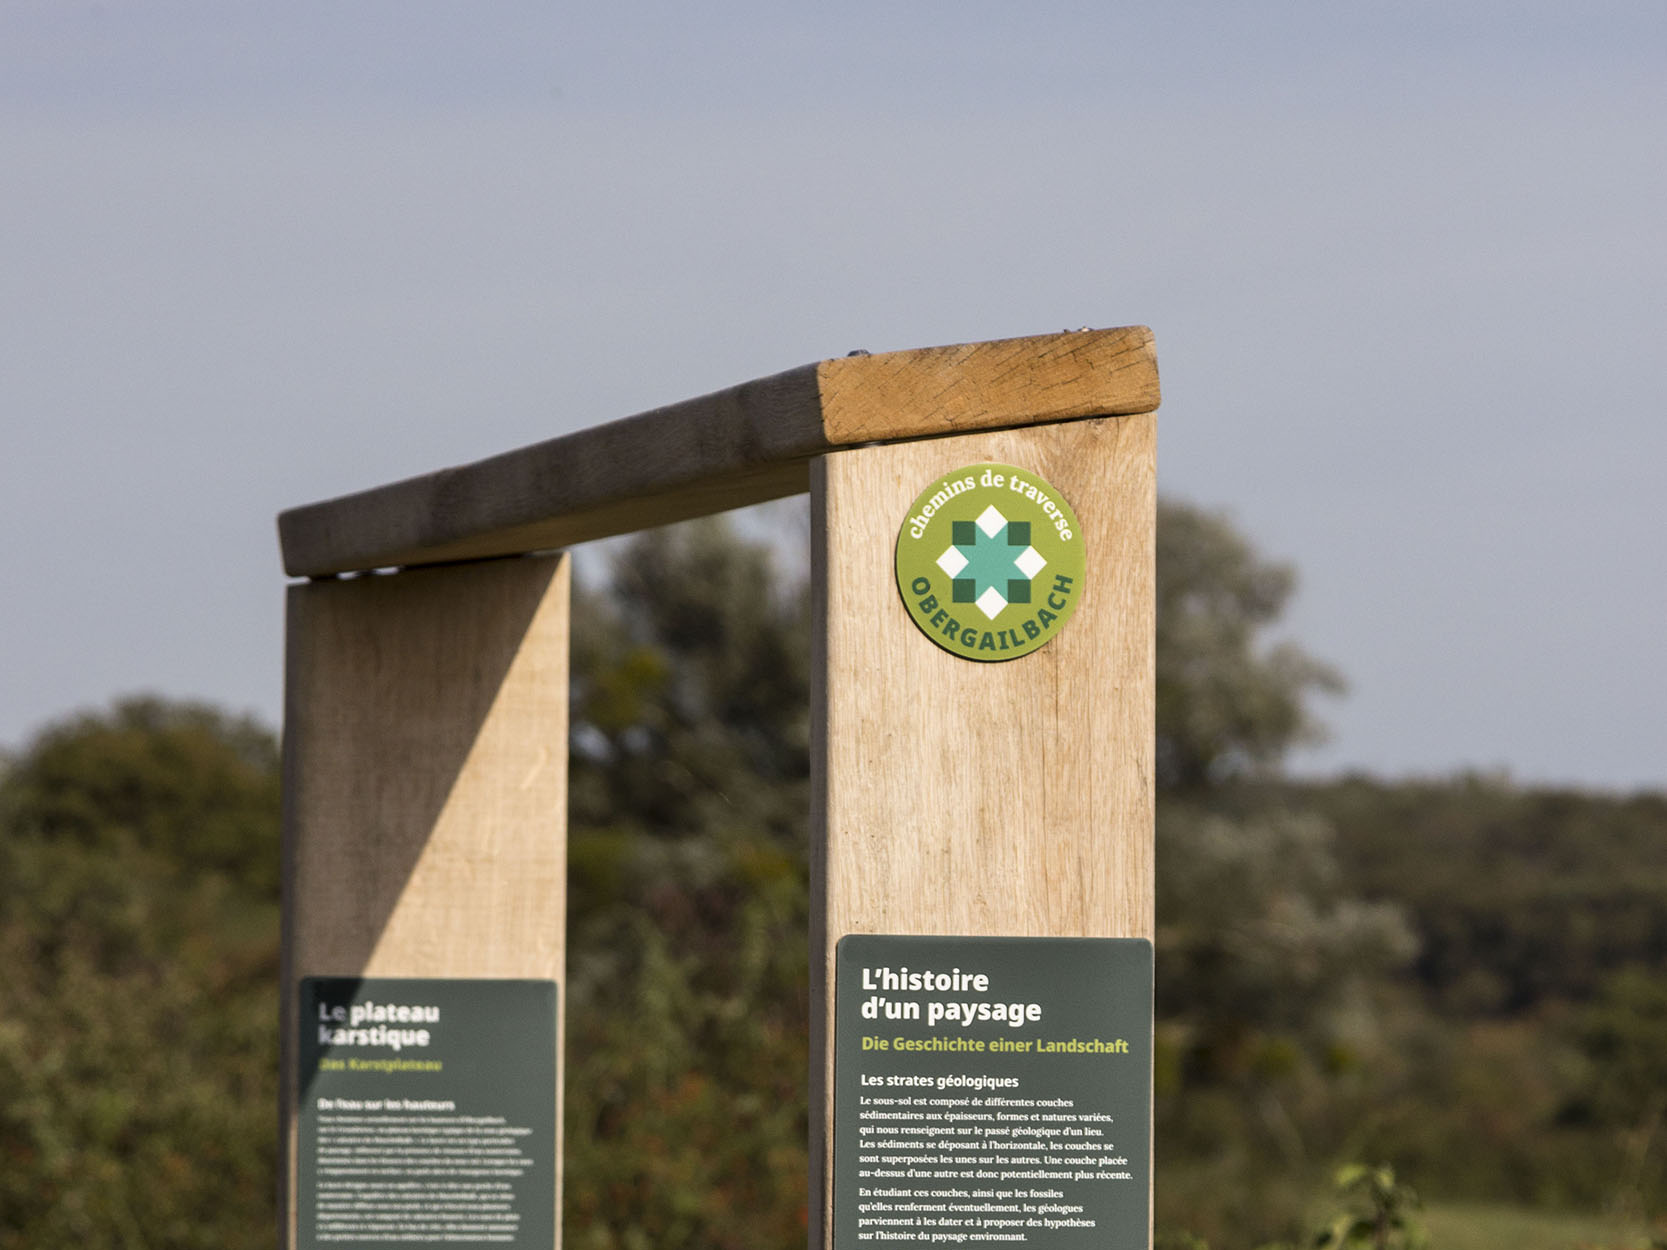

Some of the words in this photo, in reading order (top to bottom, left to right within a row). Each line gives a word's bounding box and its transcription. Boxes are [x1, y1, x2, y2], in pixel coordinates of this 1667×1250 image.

[910, 476, 976, 539] chemins
[980, 469, 1004, 487] de
[1010, 476, 1073, 541] traverse
[912, 574, 1074, 651] OBERGAILBACH
[862, 967, 989, 992] L'histoire
[319, 1002, 346, 1022] Le
[350, 1001, 440, 1026] plateau
[861, 996, 920, 1020] d'un
[928, 1003, 1042, 1027] paysage
[318, 1025, 431, 1051] karstique
[862, 1036, 889, 1051] Die
[893, 1037, 986, 1052] Geschichte
[989, 1037, 1033, 1052] einer
[1037, 1038, 1129, 1054] Landschaft
[861, 1074, 884, 1086] Les
[886, 1075, 935, 1087] strates
[937, 1075, 1019, 1091] géologiques
[860, 1096, 872, 1105] Le
[873, 1096, 912, 1106] sous-sol
[913, 1098, 928, 1106] est
[929, 1097, 970, 1109] composé
[971, 1097, 984, 1106] de
[984, 1097, 1035, 1107] différentes
[1036, 1098, 1074, 1108] couches
[859, 1110, 925, 1120] sédimentaires
[943, 1111, 996, 1123] épaisseurs,
[996, 1112, 1029, 1121] formes
[1030, 1113, 1041, 1122] et
[1042, 1114, 1078, 1122] natures
[1078, 1112, 1114, 1123] variées,
[859, 1125, 875, 1137] qui
[876, 1127, 900, 1135] nous
[900, 1125, 956, 1137] renseignent
[974, 1126, 984, 1136] le
[984, 1126, 1011, 1138] passé
[1011, 1126, 1062, 1138] géologique
[1062, 1127, 1083, 1136] d'un
[1084, 1127, 1105, 1137] lieu.
[859, 1139, 876, 1149] Les
[877, 1139, 925, 1149] sédiments
[937, 1140, 980, 1152] déposant
[981, 1140, 988, 1150] à
[989, 1140, 1049, 1151] l'horizontale,
[1050, 1141, 1064, 1151] les
[1064, 1141, 1103, 1151] couches
[859, 1155, 880, 1163] sont
[881, 1154, 939, 1166] superposées
[940, 1154, 954, 1164] les
[996, 1155, 1010, 1164] les
[1010, 1157, 1043, 1165] autres.
[1044, 1156, 1063, 1165] Une
[1064, 1155, 1098, 1165] couche
[1098, 1156, 1129, 1168] placée
[858, 1168, 906, 1178] au-dessus
[906, 1169, 933, 1178] d'une
[933, 1170, 959, 1178] autre
[960, 1170, 975, 1179] est
[976, 1169, 999, 1179] donc
[1000, 1170, 1073, 1182] potentiellement
[1074, 1170, 1095, 1182] plus
[1096, 1170, 1133, 1180] récente.
[859, 1188, 872, 1197] En
[872, 1188, 912, 1197] étudiant
[913, 1190, 930, 1198] ces
[930, 1188, 971, 1198] couches,
[972, 1189, 995, 1198] ainsi
[995, 1191, 1014, 1200] que
[1014, 1189, 1029, 1198] les
[1029, 1189, 1064, 1199] fossiles
[858, 1202, 893, 1214] qu'elles
[894, 1202, 947, 1212] renferment
[948, 1203, 1022, 1213] éventuellement,
[1023, 1203, 1037, 1213] les
[1038, 1203, 1084, 1216] géologues
[858, 1216, 914, 1229] parviennent
[916, 1216, 922, 1226] à
[923, 1217, 937, 1226] les
[938, 1217, 964, 1227] dater
[964, 1218, 975, 1227] et
[976, 1217, 982, 1227] à
[983, 1219, 1025, 1229] proposer
[1026, 1218, 1043, 1227] des
[1044, 1218, 1096, 1230] hypothèses
[875, 1231, 917, 1241] l'histoire
[917, 1231, 930, 1241] du
[931, 1233, 968, 1243] paysage
[969, 1232, 1028, 1241] environnant.
